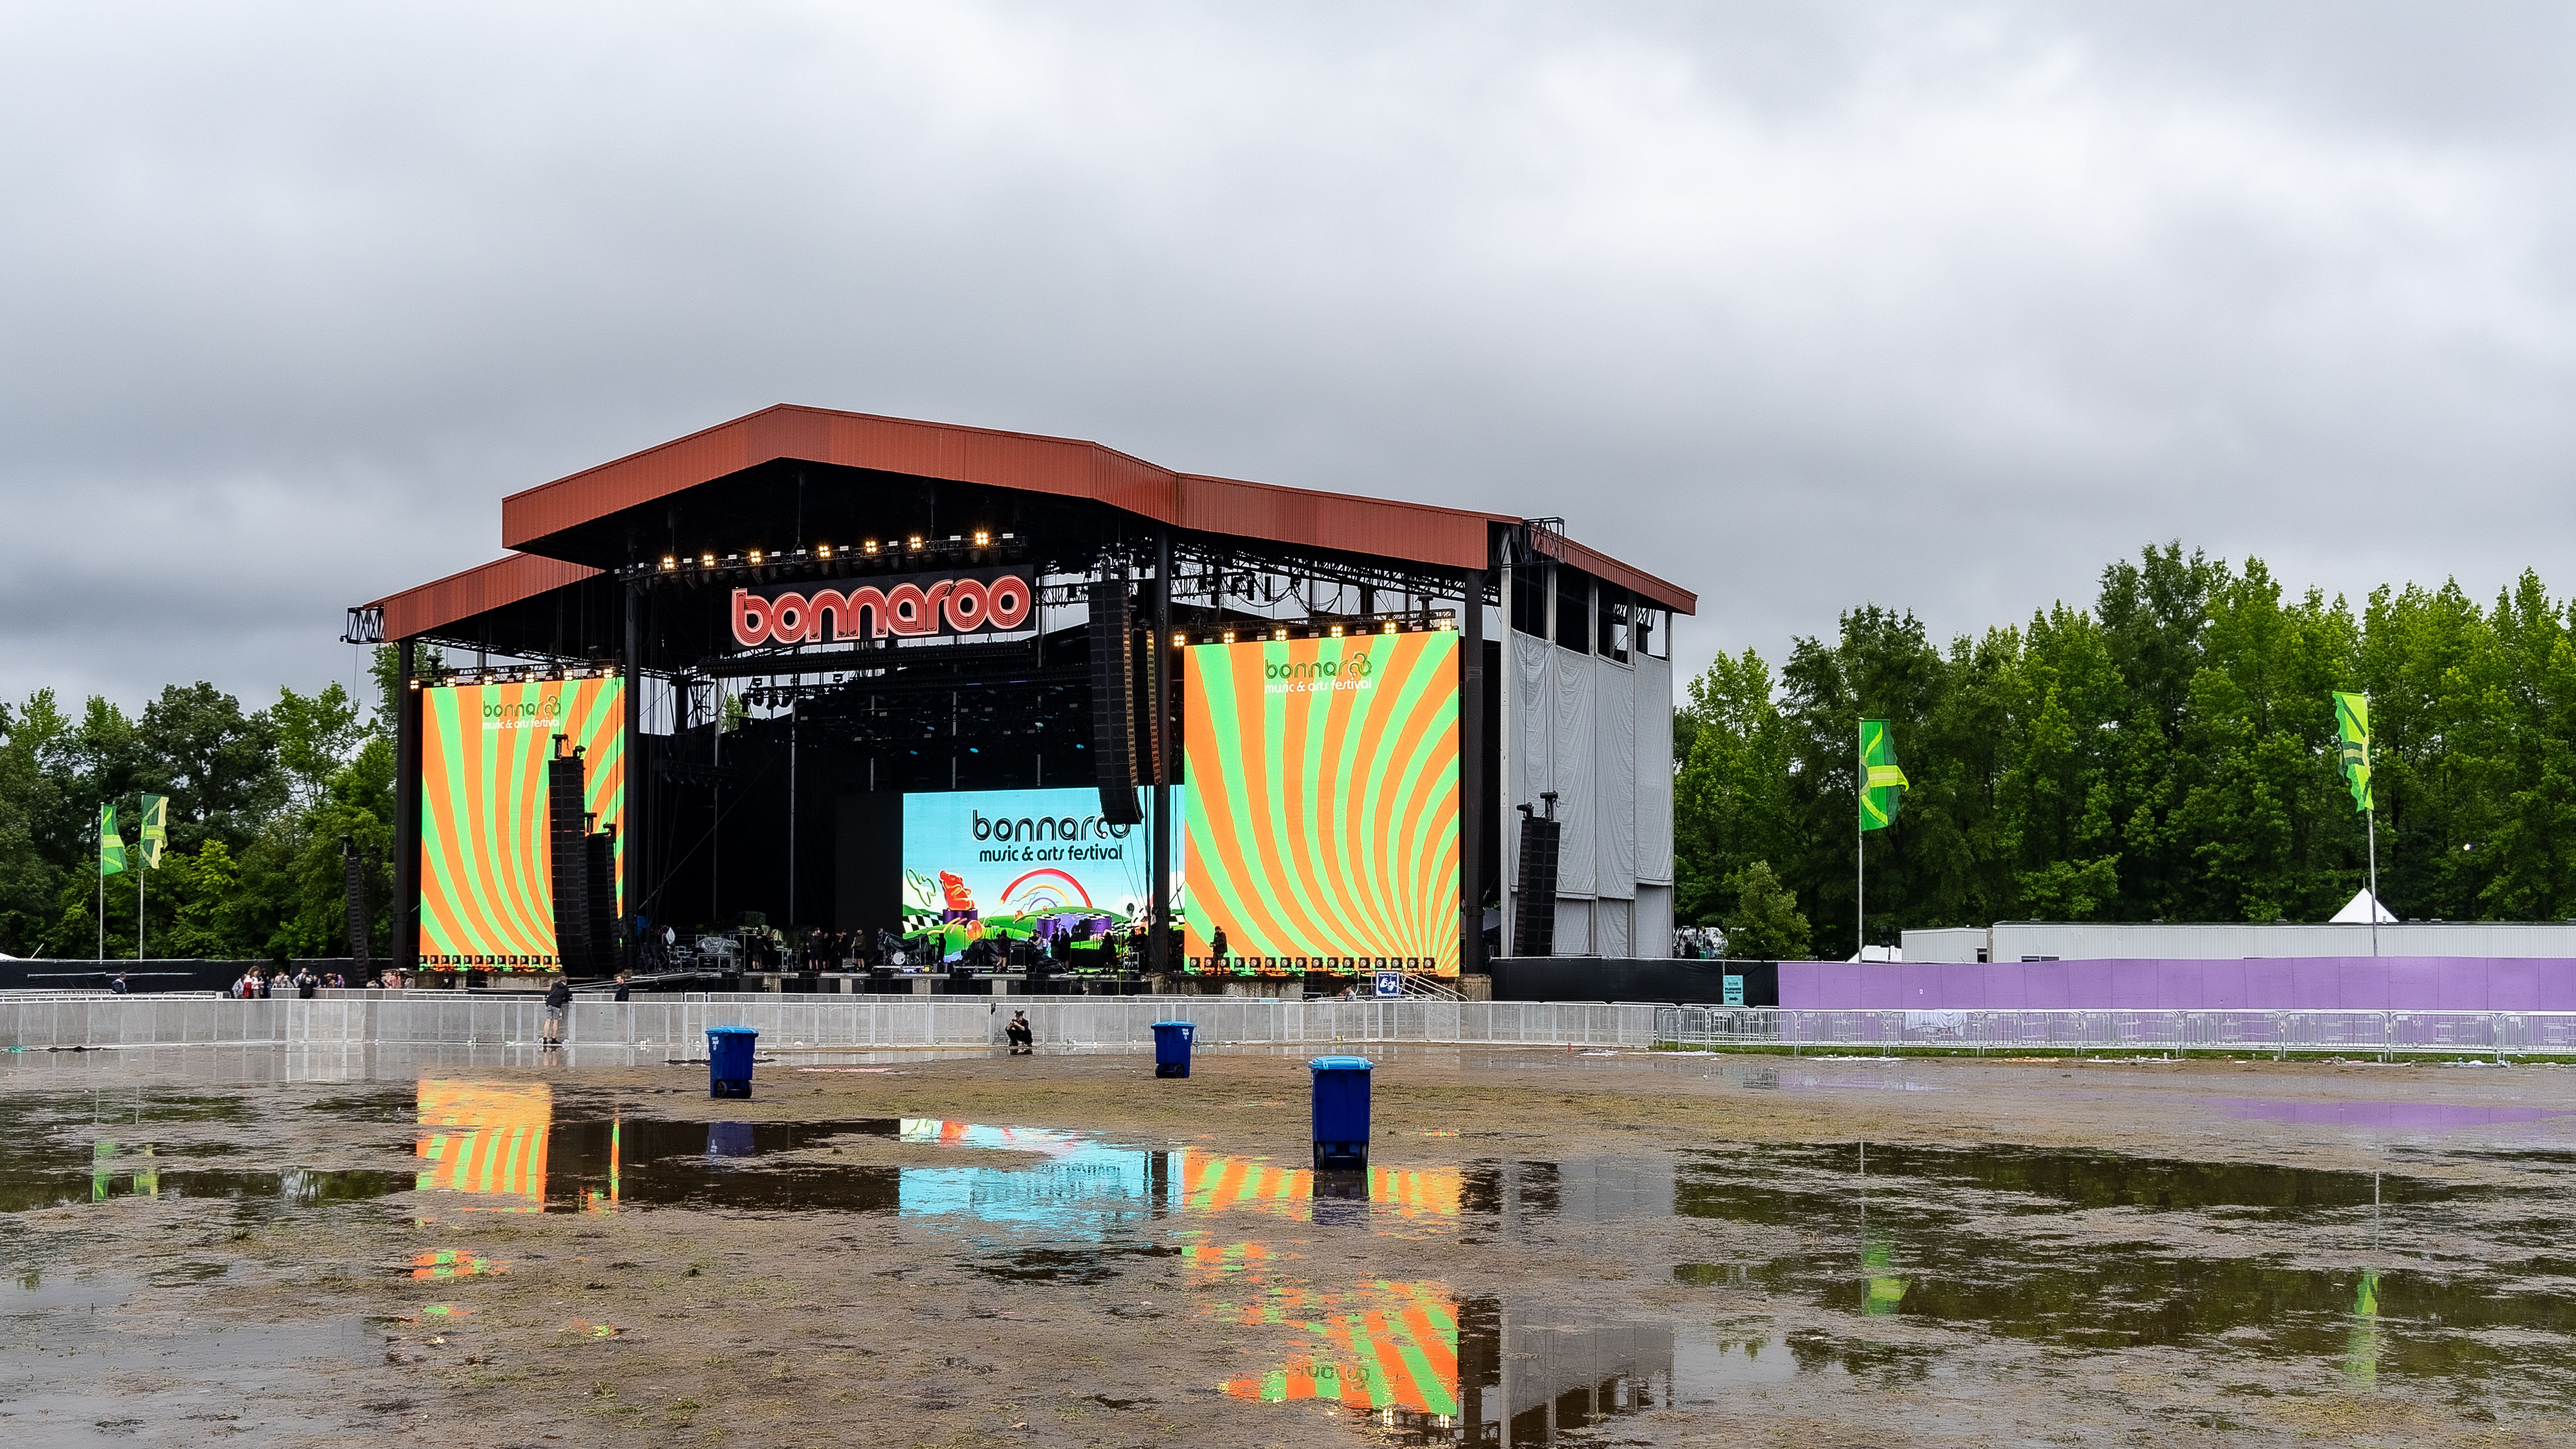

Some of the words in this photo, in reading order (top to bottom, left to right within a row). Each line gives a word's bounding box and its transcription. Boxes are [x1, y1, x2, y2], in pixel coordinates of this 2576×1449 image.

[732, 575, 1030, 646] bonnaroo
[1264, 681, 1294, 694] music
[1296, 681, 1306, 693] &
[1308, 680, 1328, 692] arts
[1331, 677, 1372, 690] festival
[483, 719, 504, 730] music
[505, 719, 513, 729] &
[513, 719, 530, 729] arts
[979, 845, 1019, 862] music
[1022, 846, 1033, 861] &
[1037, 846, 1064, 861] arts
[1067, 843, 1122, 861] festival
